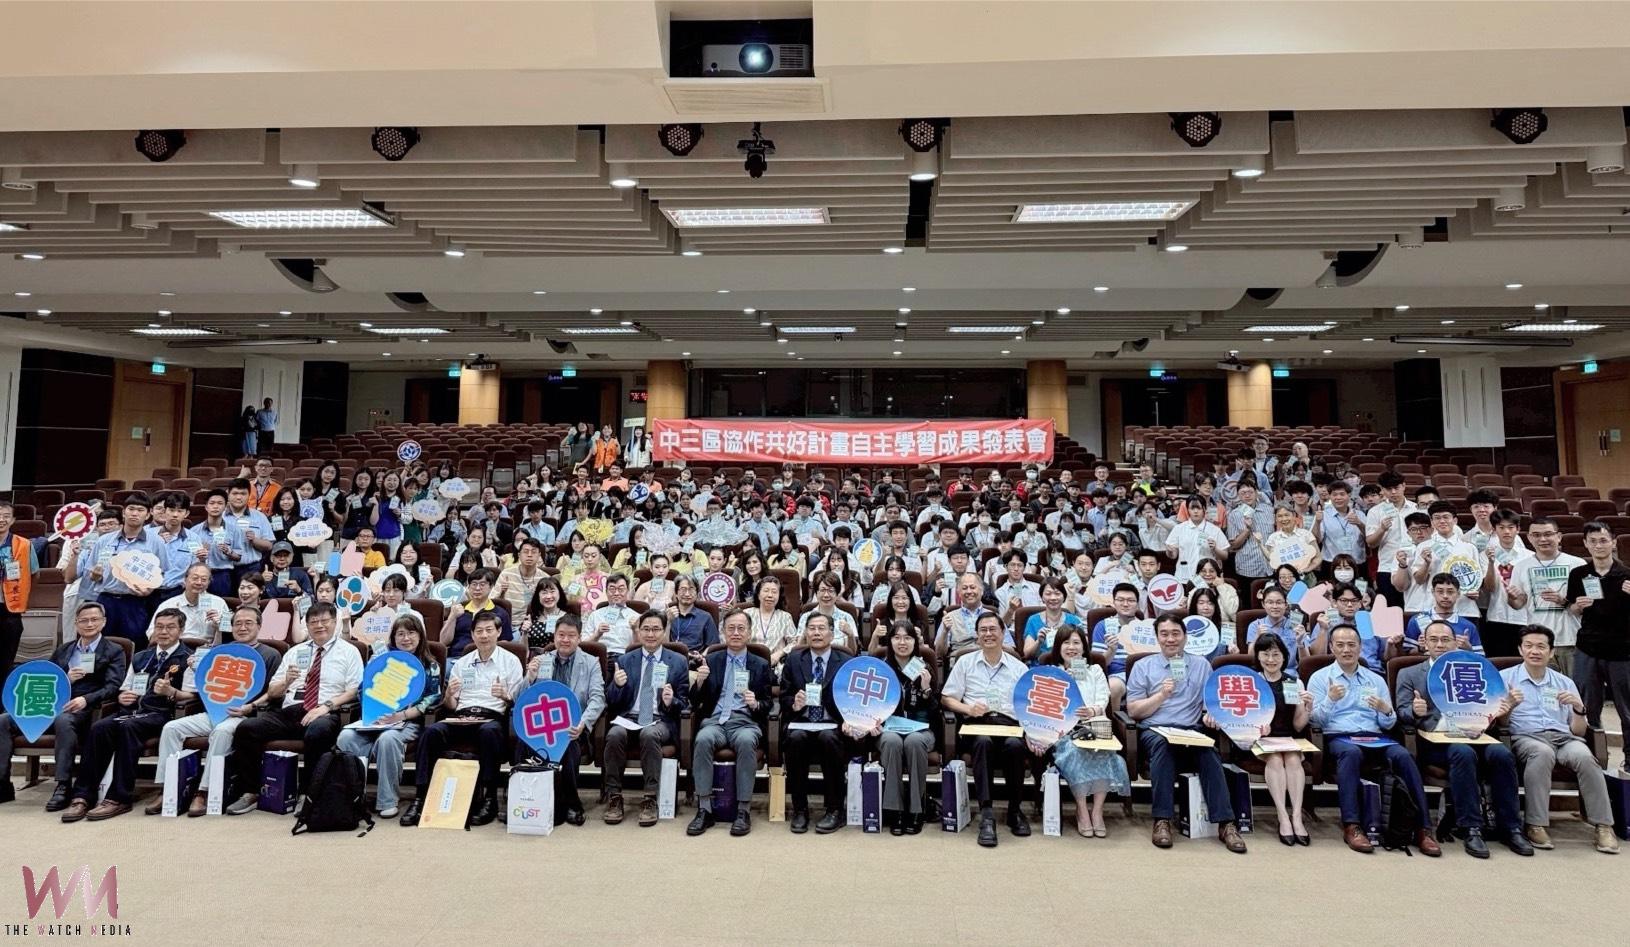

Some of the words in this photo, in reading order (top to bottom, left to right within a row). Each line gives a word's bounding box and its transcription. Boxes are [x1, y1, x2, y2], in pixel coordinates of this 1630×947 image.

[659, 427, 1048, 457] 中三區協作共好計畫自主學習成果發表會
[14, 672, 59, 719] 優
[204, 655, 257, 704] 學
[848, 667, 890, 707] 中
[1026, 674, 1072, 721] 臺
[1217, 674, 1260, 718] 學
[1438, 660, 1489, 706] 優
[520, 694, 573, 747] 中
